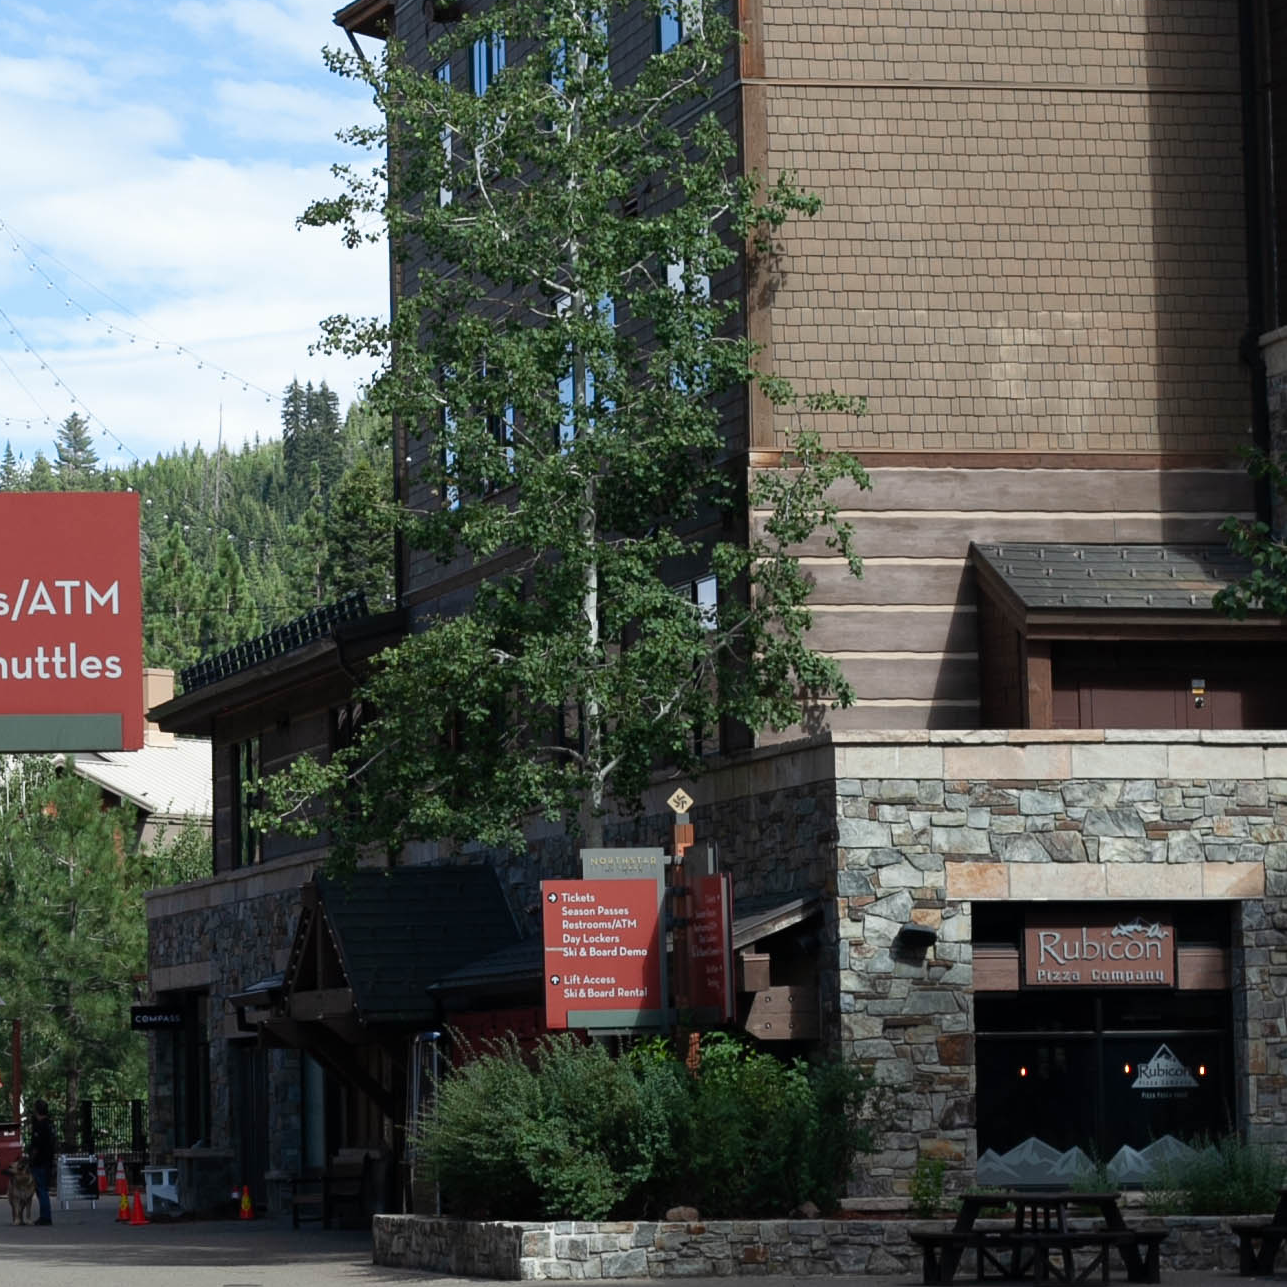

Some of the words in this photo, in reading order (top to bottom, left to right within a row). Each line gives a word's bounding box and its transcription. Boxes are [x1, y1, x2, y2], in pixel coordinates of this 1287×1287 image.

[590, 856, 657, 865] NORTHSTAR
[561, 892, 596, 903] Tickets
[561, 906, 595, 917] Season
[597, 905, 630, 916] Passes
[562, 919, 637, 930] Restrooms/ATM
[563, 934, 581, 946] Day
[583, 933, 620, 944] Lockers
[563, 946, 577, 957] Ski
[579, 947, 588, 957] &
[589, 946, 618, 957] Board
[619, 945, 648, 957] Demo
[1038, 927, 1162, 965] Rubicon
[563, 975, 581, 985] Lift
[583, 974, 616, 985] Access
[1037, 969, 1081, 982] Pizza
[1092, 969, 1164, 984] Company
[563, 988, 578, 999] Ski
[578, 989, 587, 999] &
[587, 987, 615, 999] Board
[617, 986, 648, 998] Rental
